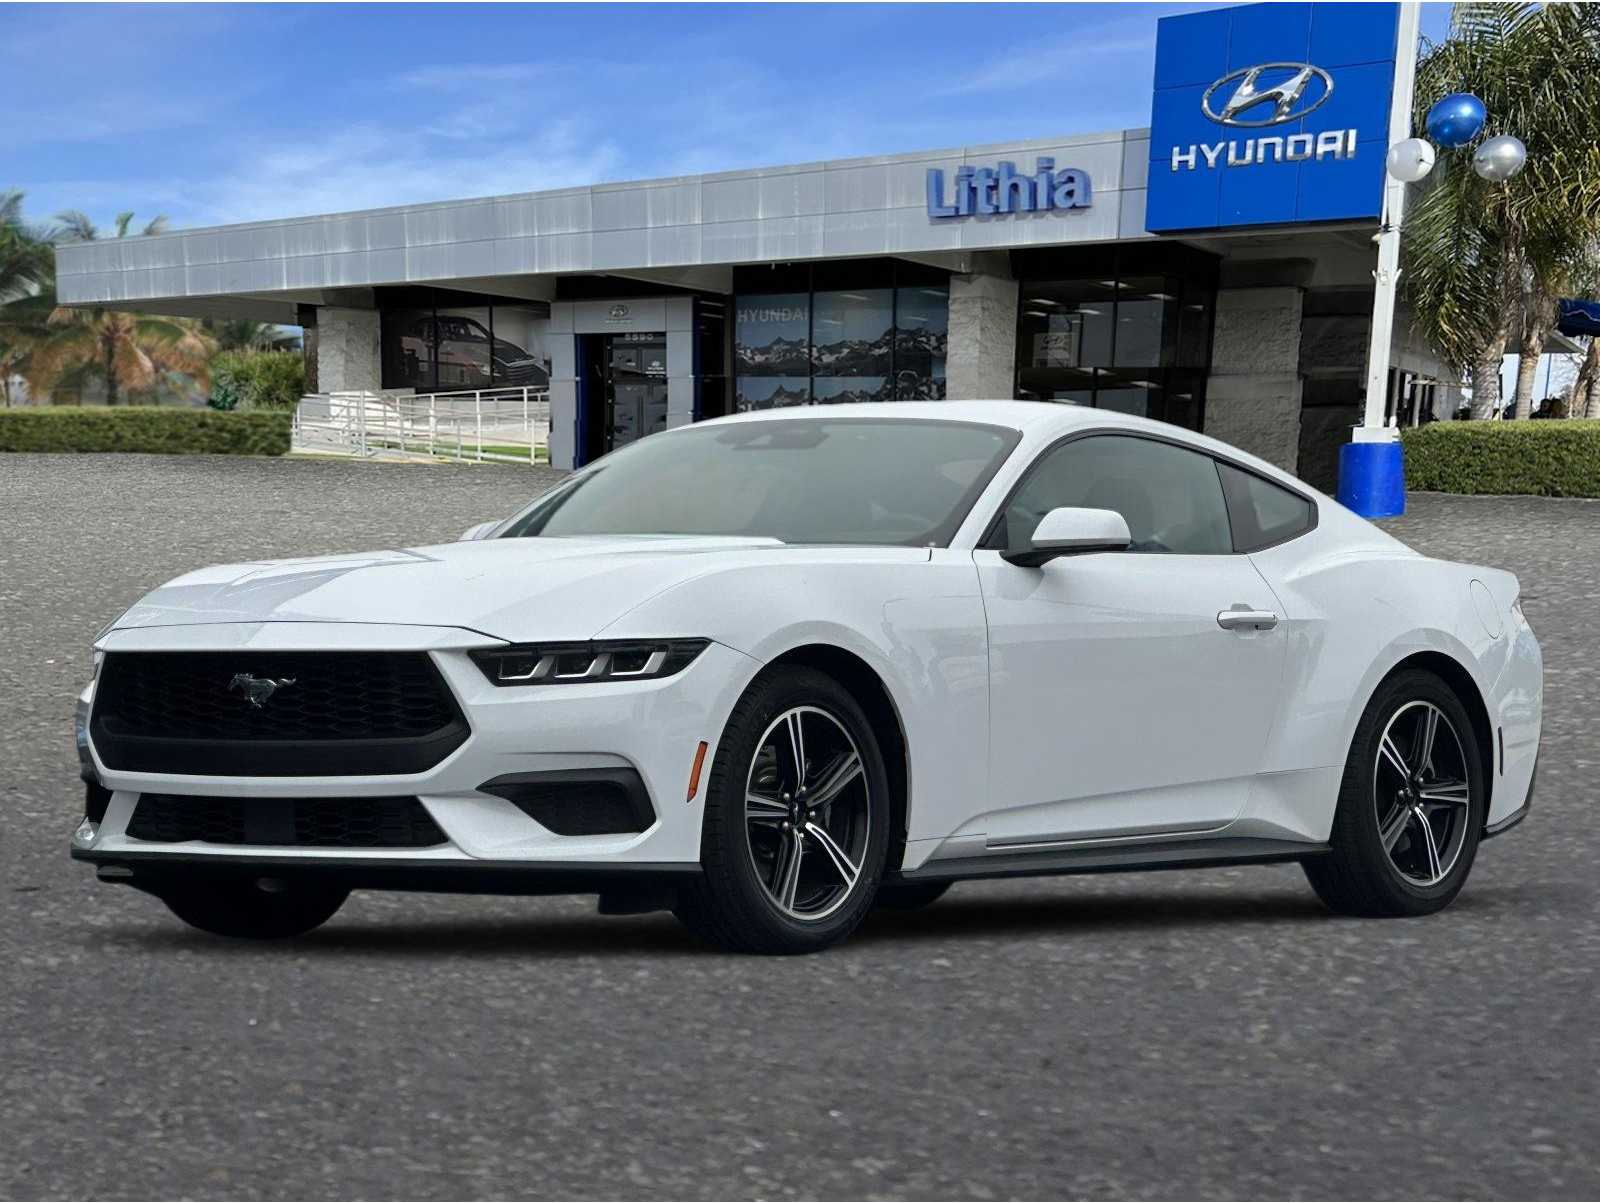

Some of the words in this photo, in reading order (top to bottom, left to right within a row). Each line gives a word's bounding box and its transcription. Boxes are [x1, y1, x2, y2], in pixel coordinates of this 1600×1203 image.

[1171, 128, 1358, 172] HYUNDAI
[926, 156, 1093, 218] Lithia
[737, 307, 809, 322] HYUNDAI
